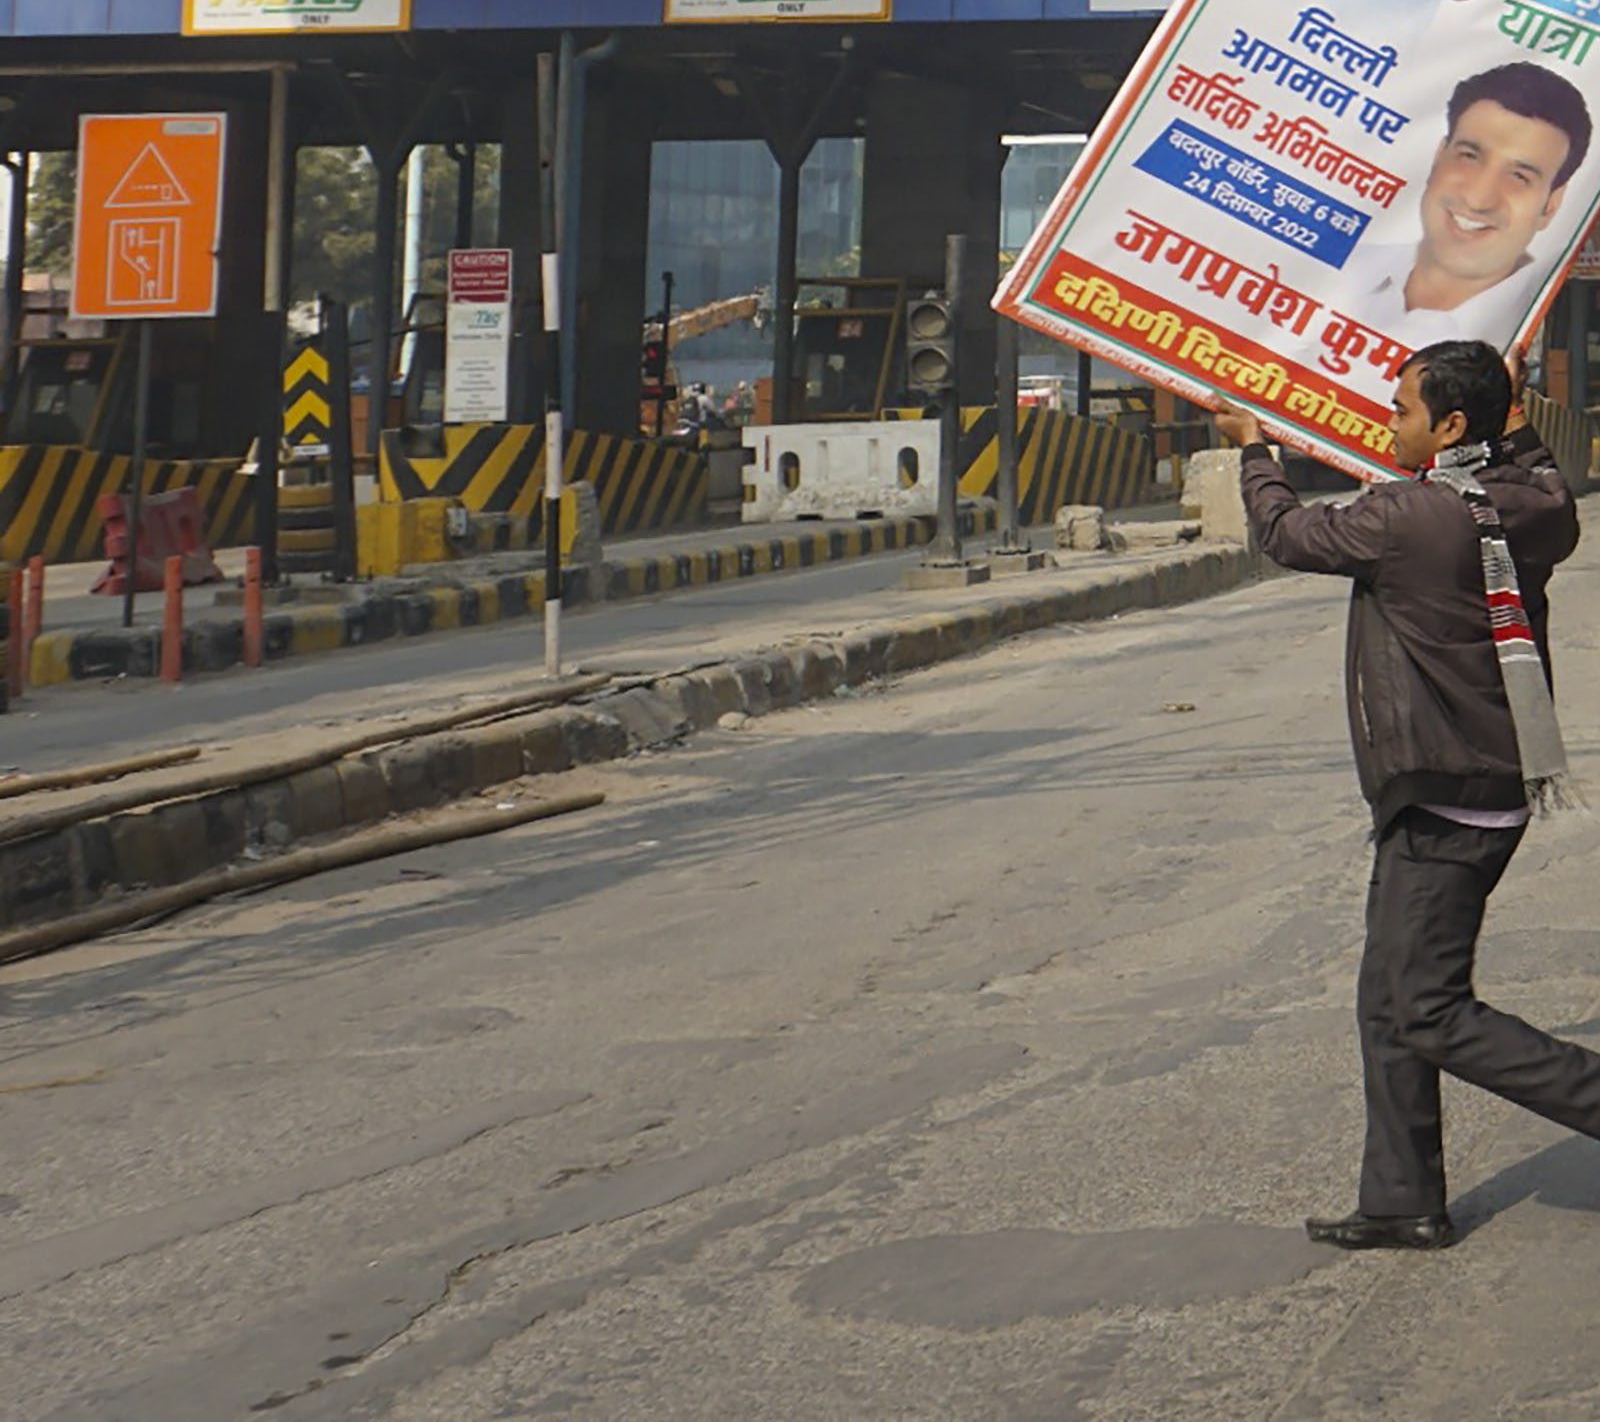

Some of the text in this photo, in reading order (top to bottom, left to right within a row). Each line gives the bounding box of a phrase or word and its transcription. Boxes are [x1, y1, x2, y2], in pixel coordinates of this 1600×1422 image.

[1222, 28, 1410, 144] आगमन पर
[1289, 6, 1397, 88] दिल्ली
[1167, 63, 1407, 209] हार्दिक अभिनन्दन
[1168, 129, 1226, 171] बदरपुर
[1273, 182, 1314, 215] सुबह
[1314, 207, 1327, 221] 6
[1330, 212, 1362, 236] बजे
[1183, 171, 1209, 193] 24
[1273, 219, 1321, 249] 2022
[1114, 209, 1324, 337] जगप्रवेश
[1319, 309, 1411, 383] कुम
[1054, 271, 1184, 351] दक्षिणी
[1178, 329, 1291, 403] दिल्ली
[1284, 383, 1398, 455] लोकस
